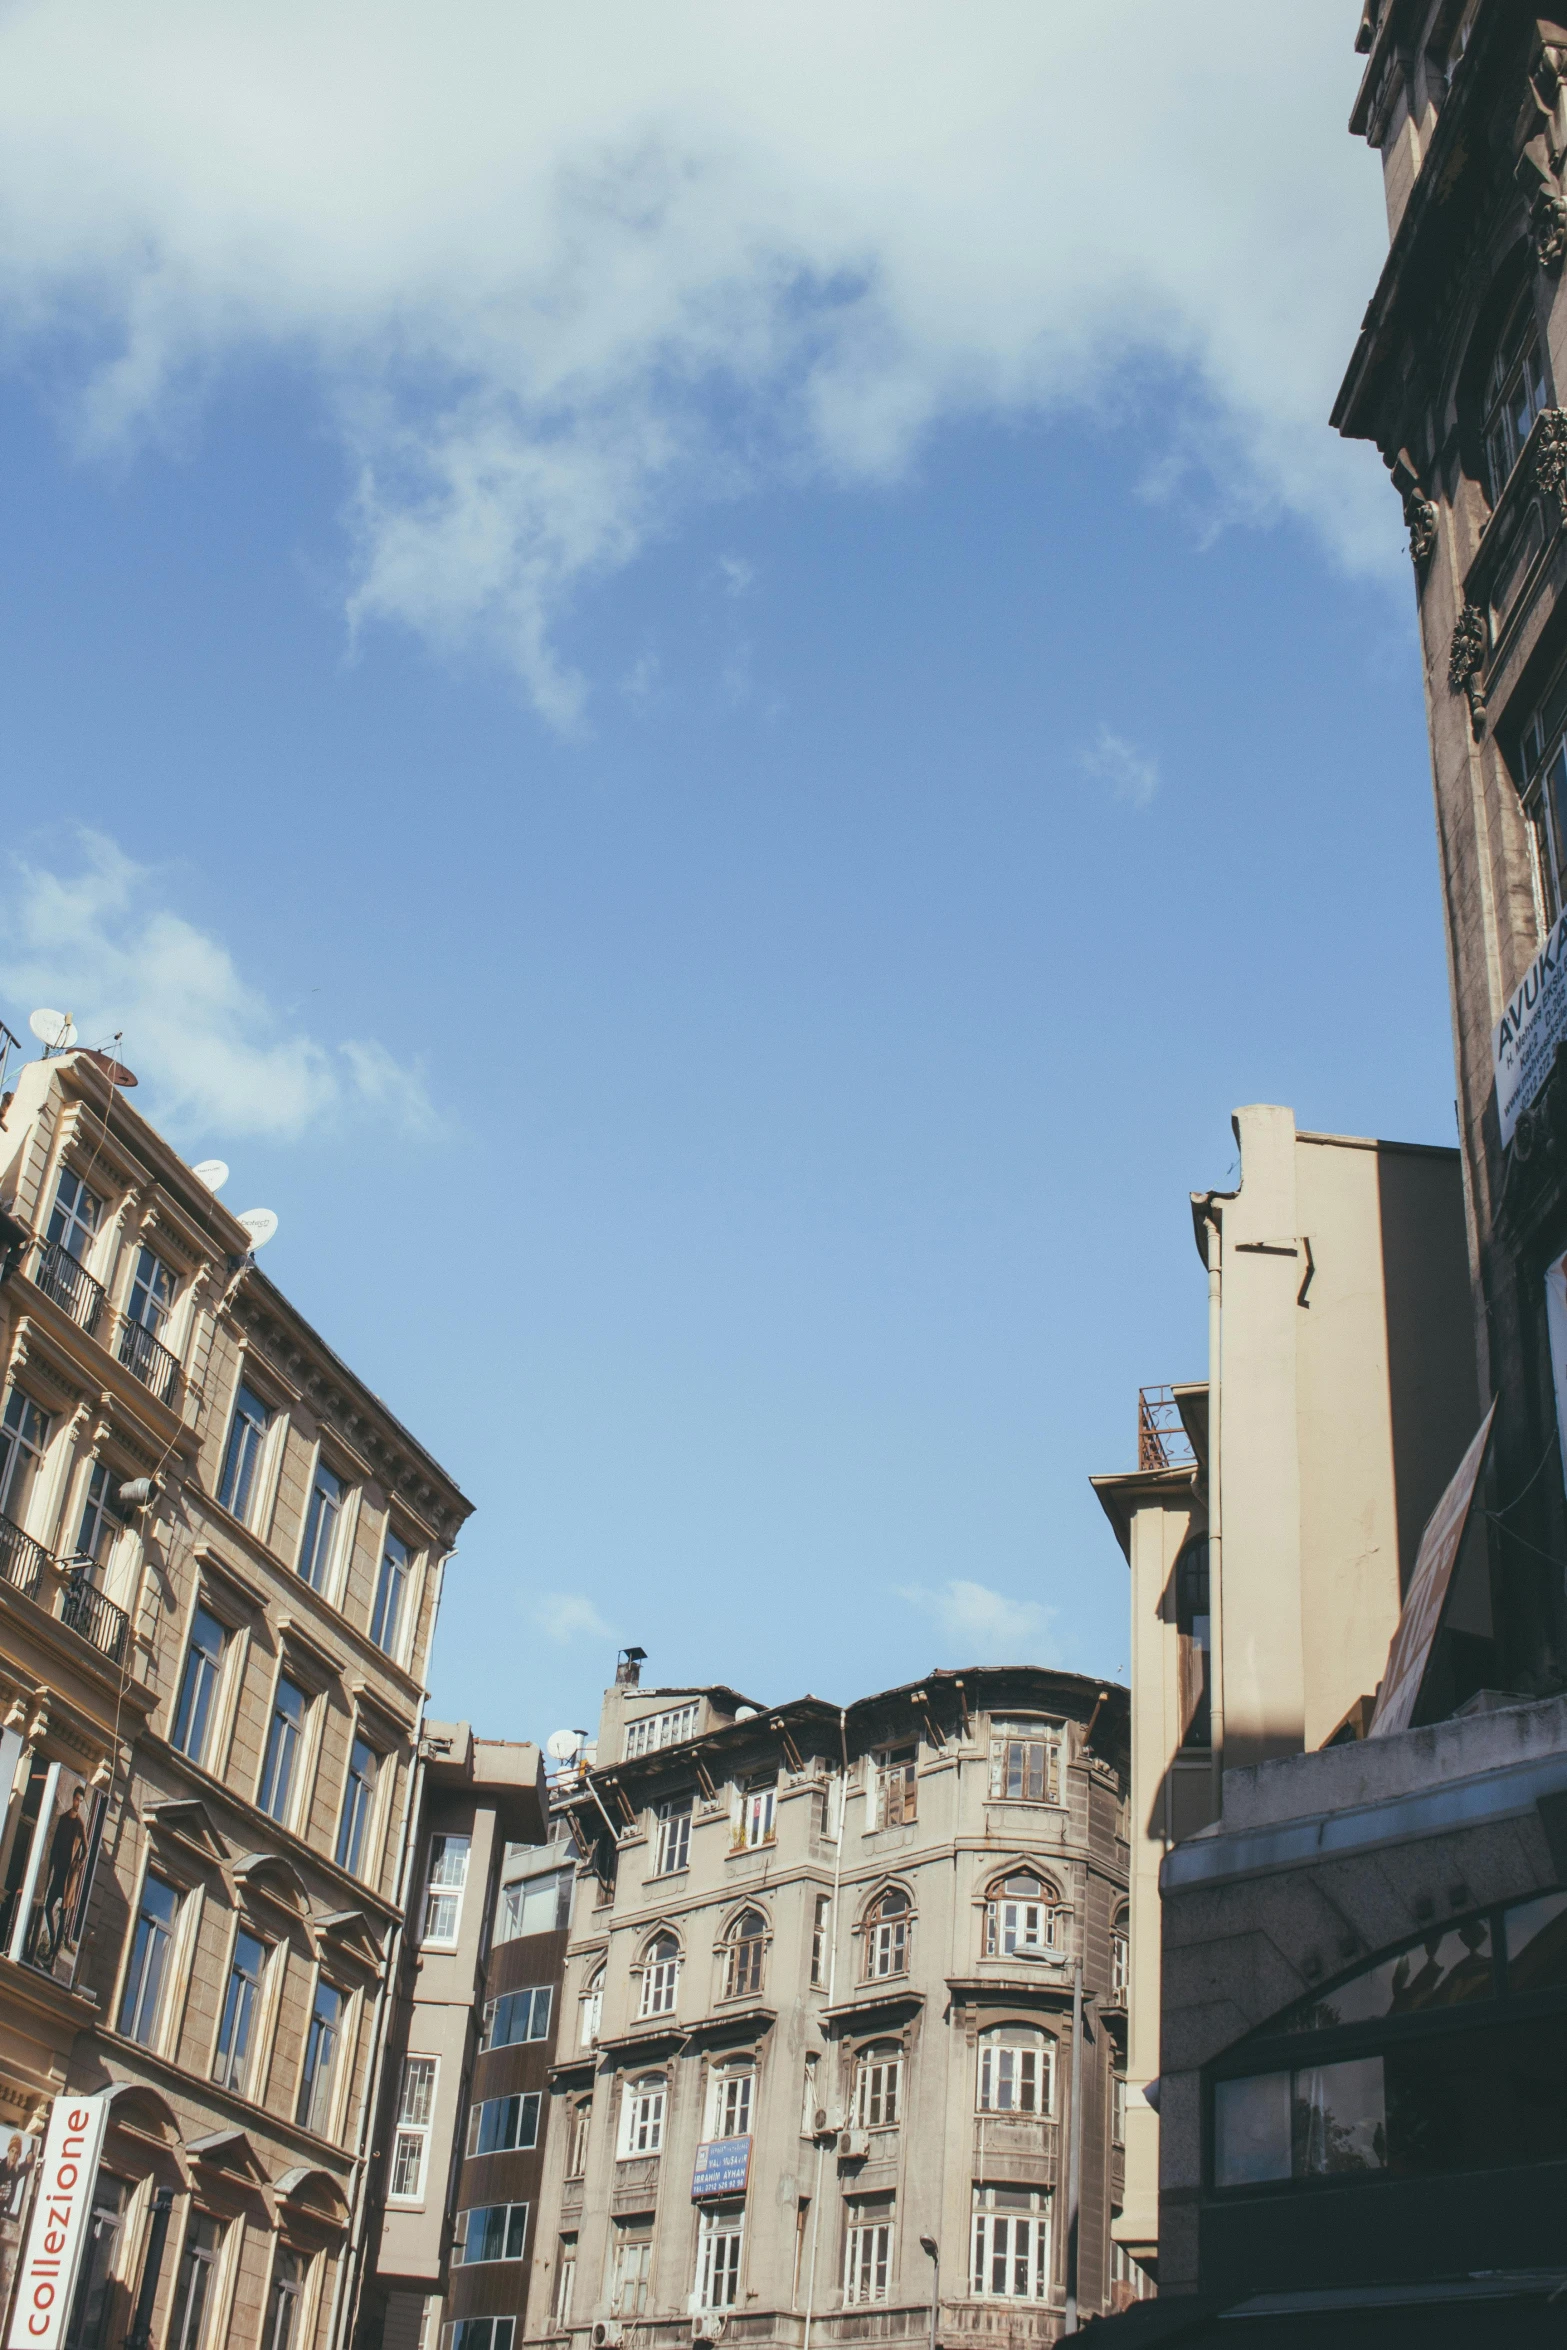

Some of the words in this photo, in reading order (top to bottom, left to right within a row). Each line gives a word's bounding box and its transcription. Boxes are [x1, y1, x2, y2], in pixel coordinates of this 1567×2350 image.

[1498, 914, 1567, 1062] AVUKA
[28, 2109, 90, 2336] collezione
[723, 2168, 746, 2180] AYHAN
